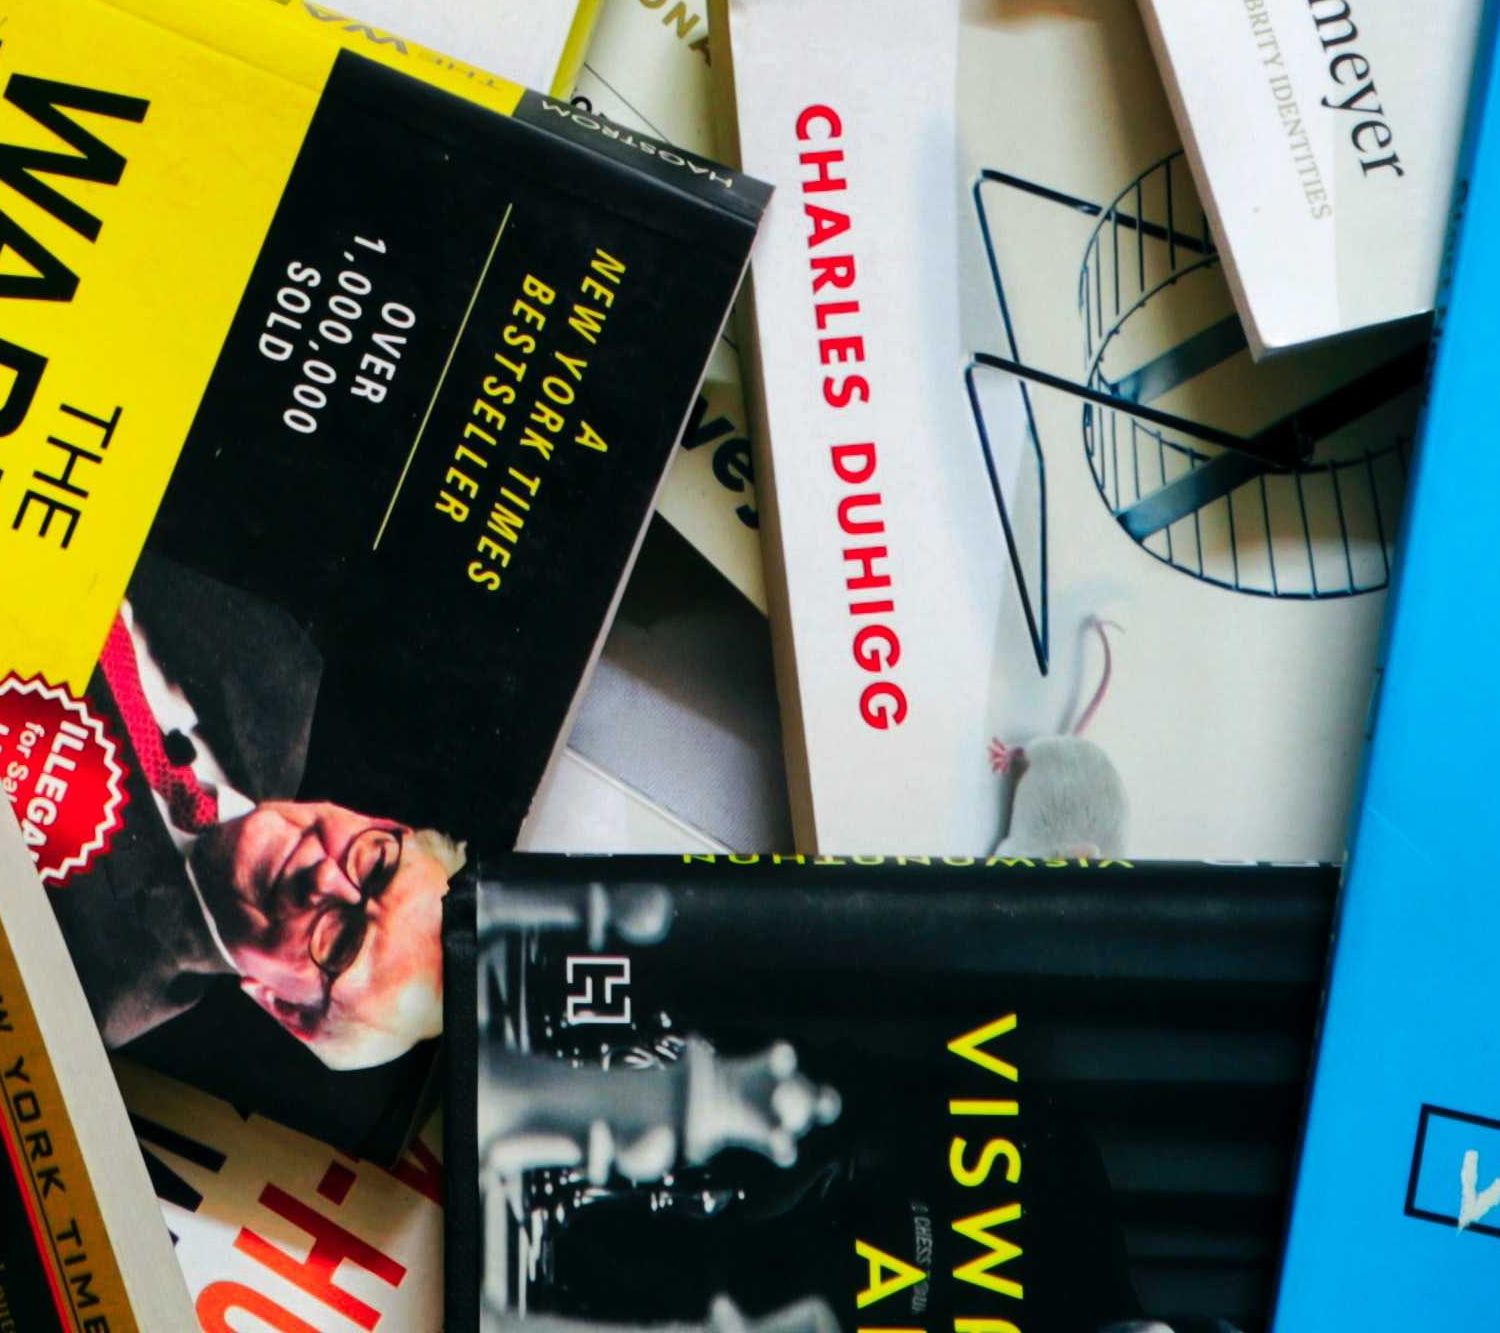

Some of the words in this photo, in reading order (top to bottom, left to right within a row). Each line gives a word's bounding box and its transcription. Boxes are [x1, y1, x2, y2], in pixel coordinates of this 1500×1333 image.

[258, 260, 320, 366] SOLD
[279, 237, 388, 436] 1,000,000
[794, 104, 870, 408] CHARLES
[352, 301, 417, 407] OVER
[12, 401, 123, 551] THE
[829, 441, 907, 730] DUHIGG
